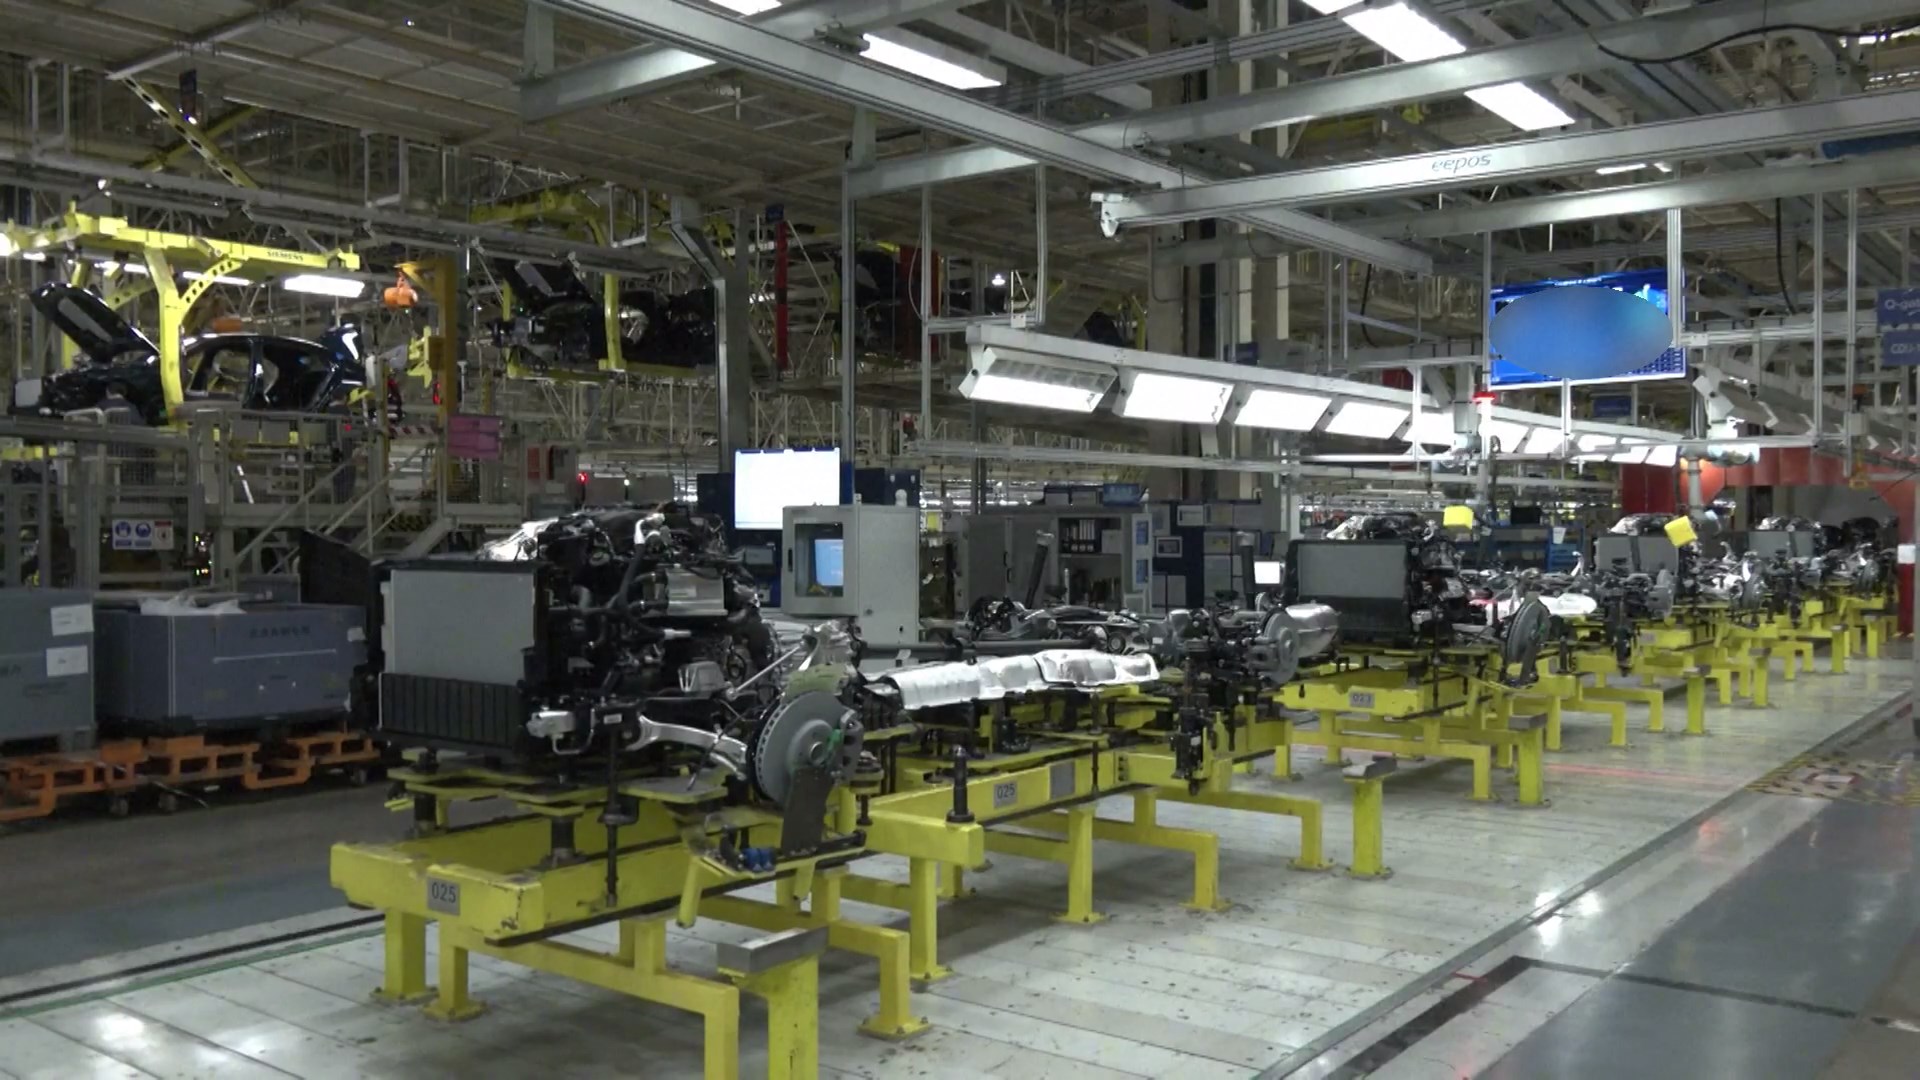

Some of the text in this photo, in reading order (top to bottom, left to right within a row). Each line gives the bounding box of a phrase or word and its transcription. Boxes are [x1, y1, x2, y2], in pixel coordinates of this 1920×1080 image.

[1431, 155, 1491, 174] eepos
[996, 783, 1015, 800] 025
[431, 882, 456, 904] 025
